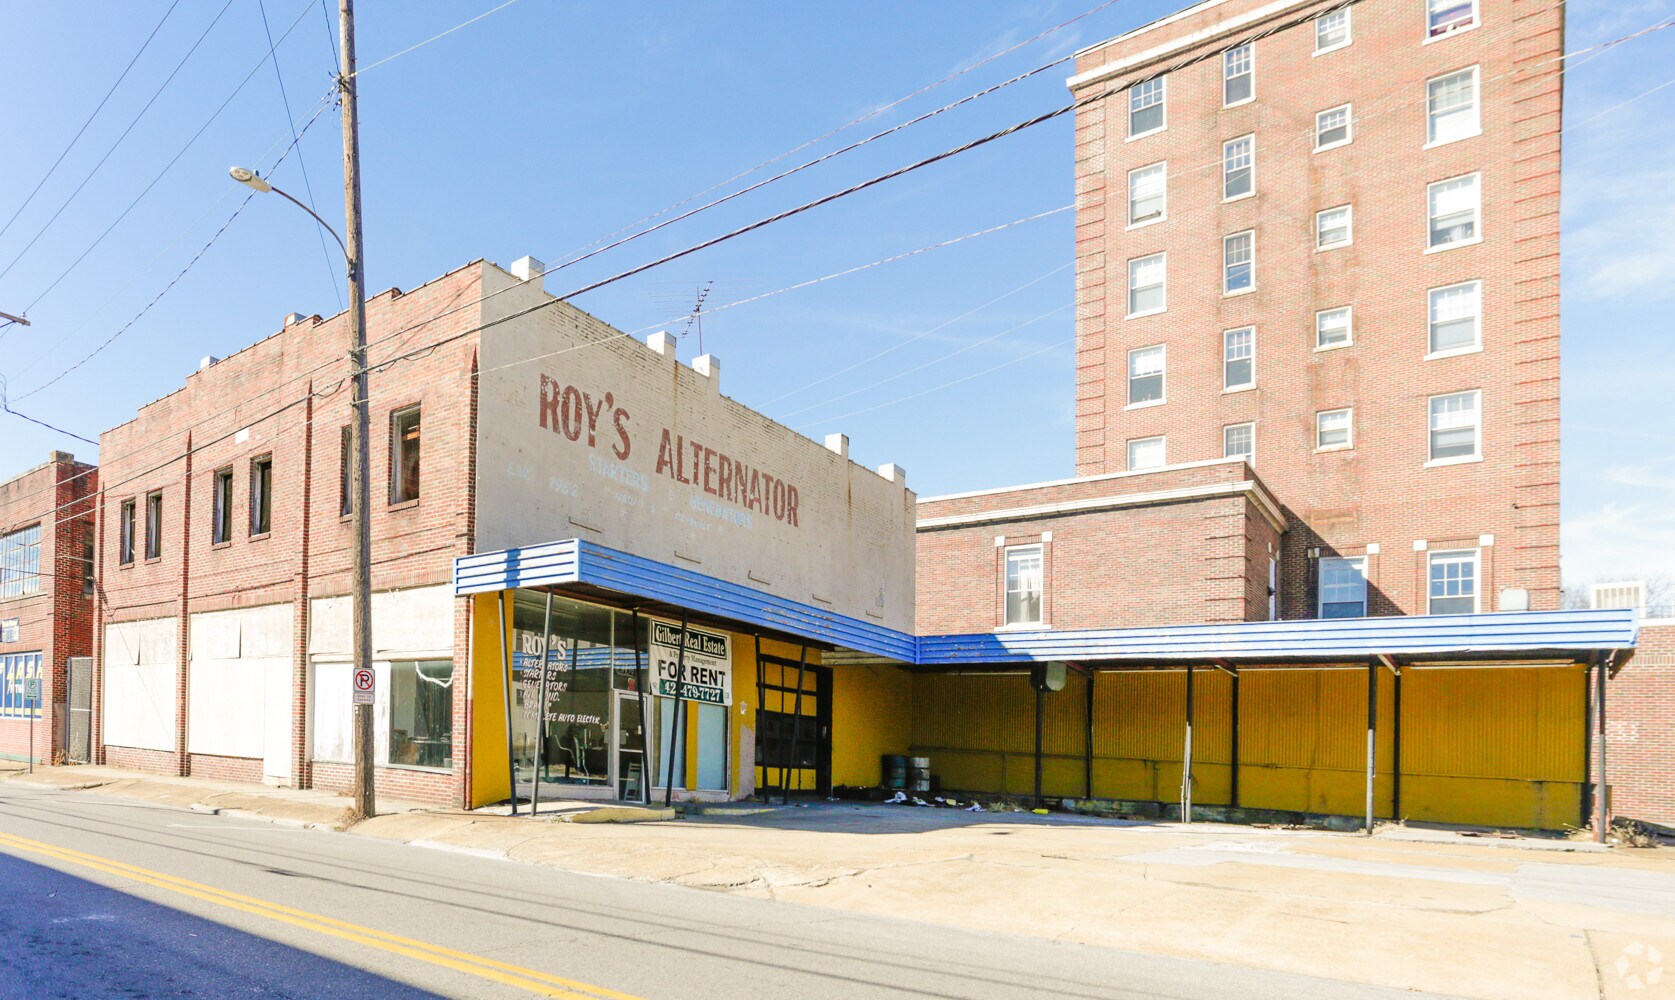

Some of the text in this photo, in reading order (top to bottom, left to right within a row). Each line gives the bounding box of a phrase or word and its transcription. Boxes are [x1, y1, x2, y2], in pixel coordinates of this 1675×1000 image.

[539, 373, 799, 528] ROY'S ALTERNATOR
[684, 632, 701, 650] Real
[703, 636, 725, 655] Estate
[523, 658, 568, 673] ALTERATORS
[658, 659, 686, 681] FOR
[691, 665, 726, 687] RENT
[523, 669, 557, 681] STARTRS
[522, 680, 568, 692] GENEATORS
[664, 681, 721, 702] 42-479-7727
[558, 712, 575, 722] AUTO
